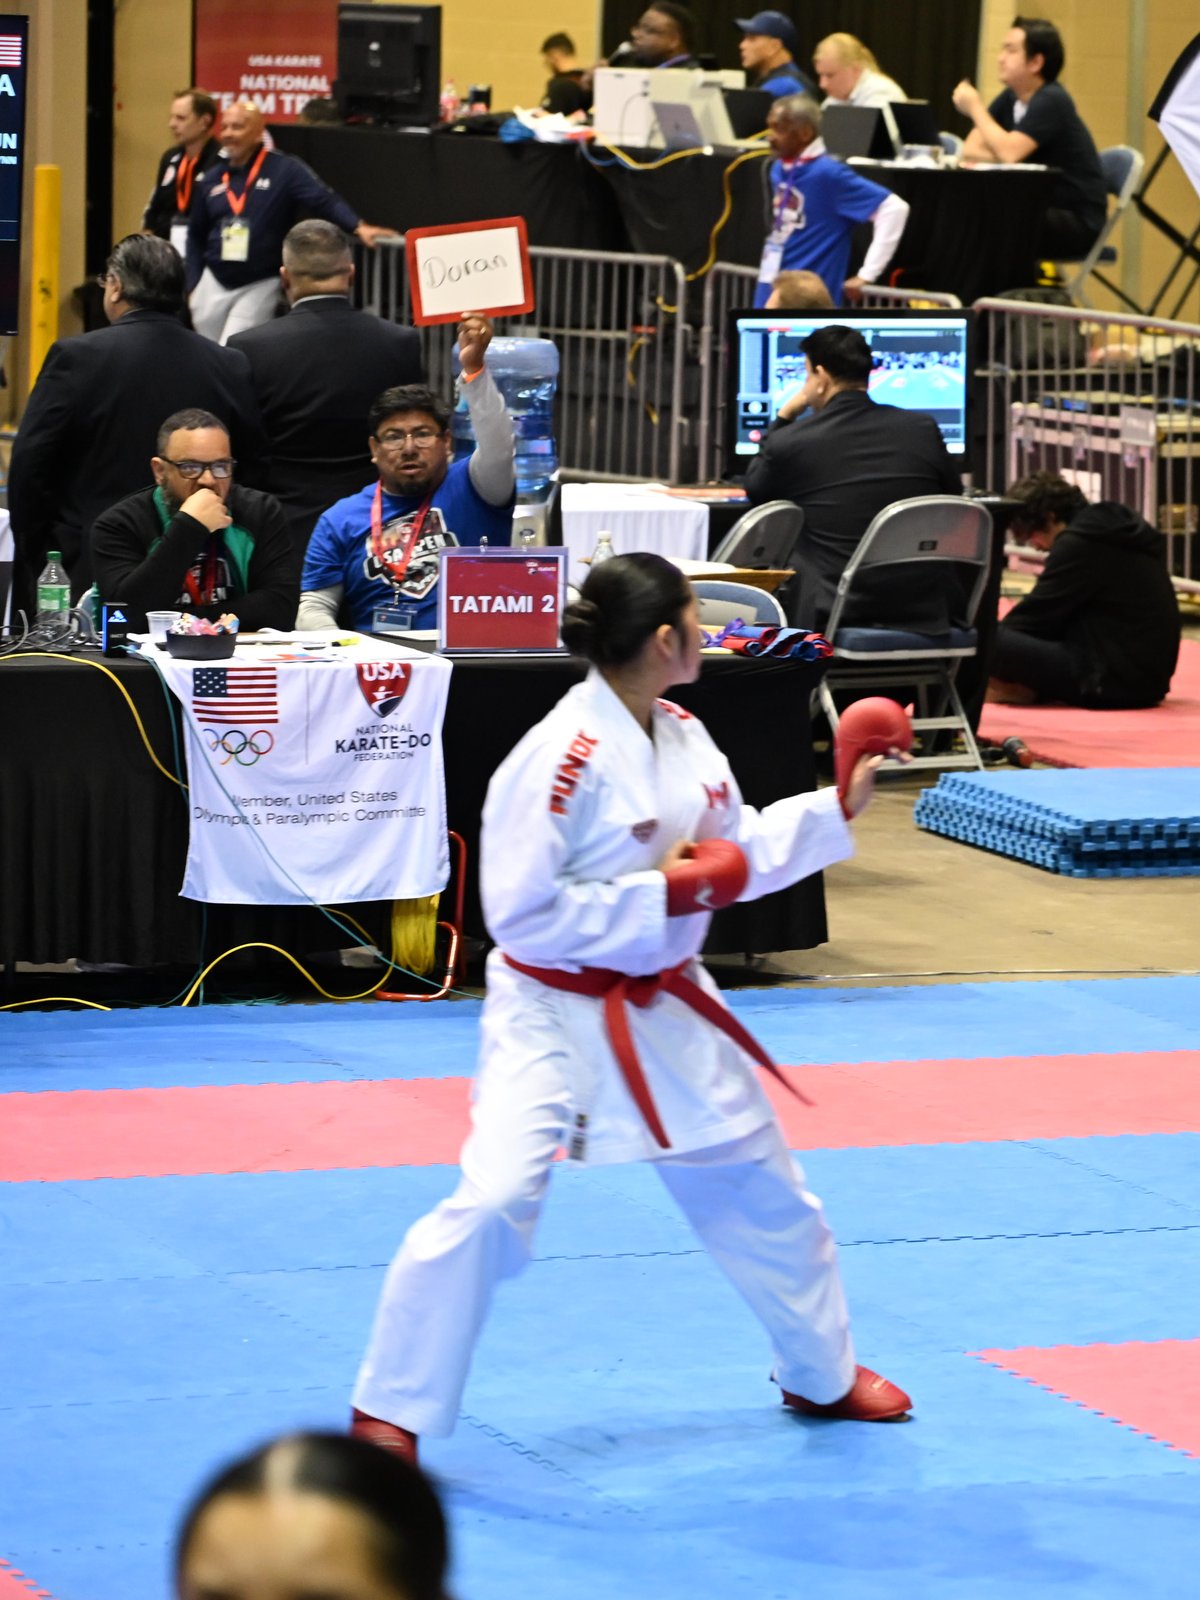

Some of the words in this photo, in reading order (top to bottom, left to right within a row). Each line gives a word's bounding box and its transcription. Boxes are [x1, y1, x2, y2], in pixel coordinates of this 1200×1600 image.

[240, 74, 330, 92] NATIONAL
[411, 533, 446, 557] PEN
[449, 595, 533, 613] TATAMI
[541, 594, 555, 613] 2
[362, 662, 405, 681] USA
[356, 723, 413, 736] NATIONAL
[335, 733, 432, 753] KARATE-DO
[354, 751, 414, 762] FEDERATION
[298, 791, 345, 806] United
[350, 790, 398, 803] States
[252, 814, 262, 825] &
[266, 809, 350, 827] Paralympic
